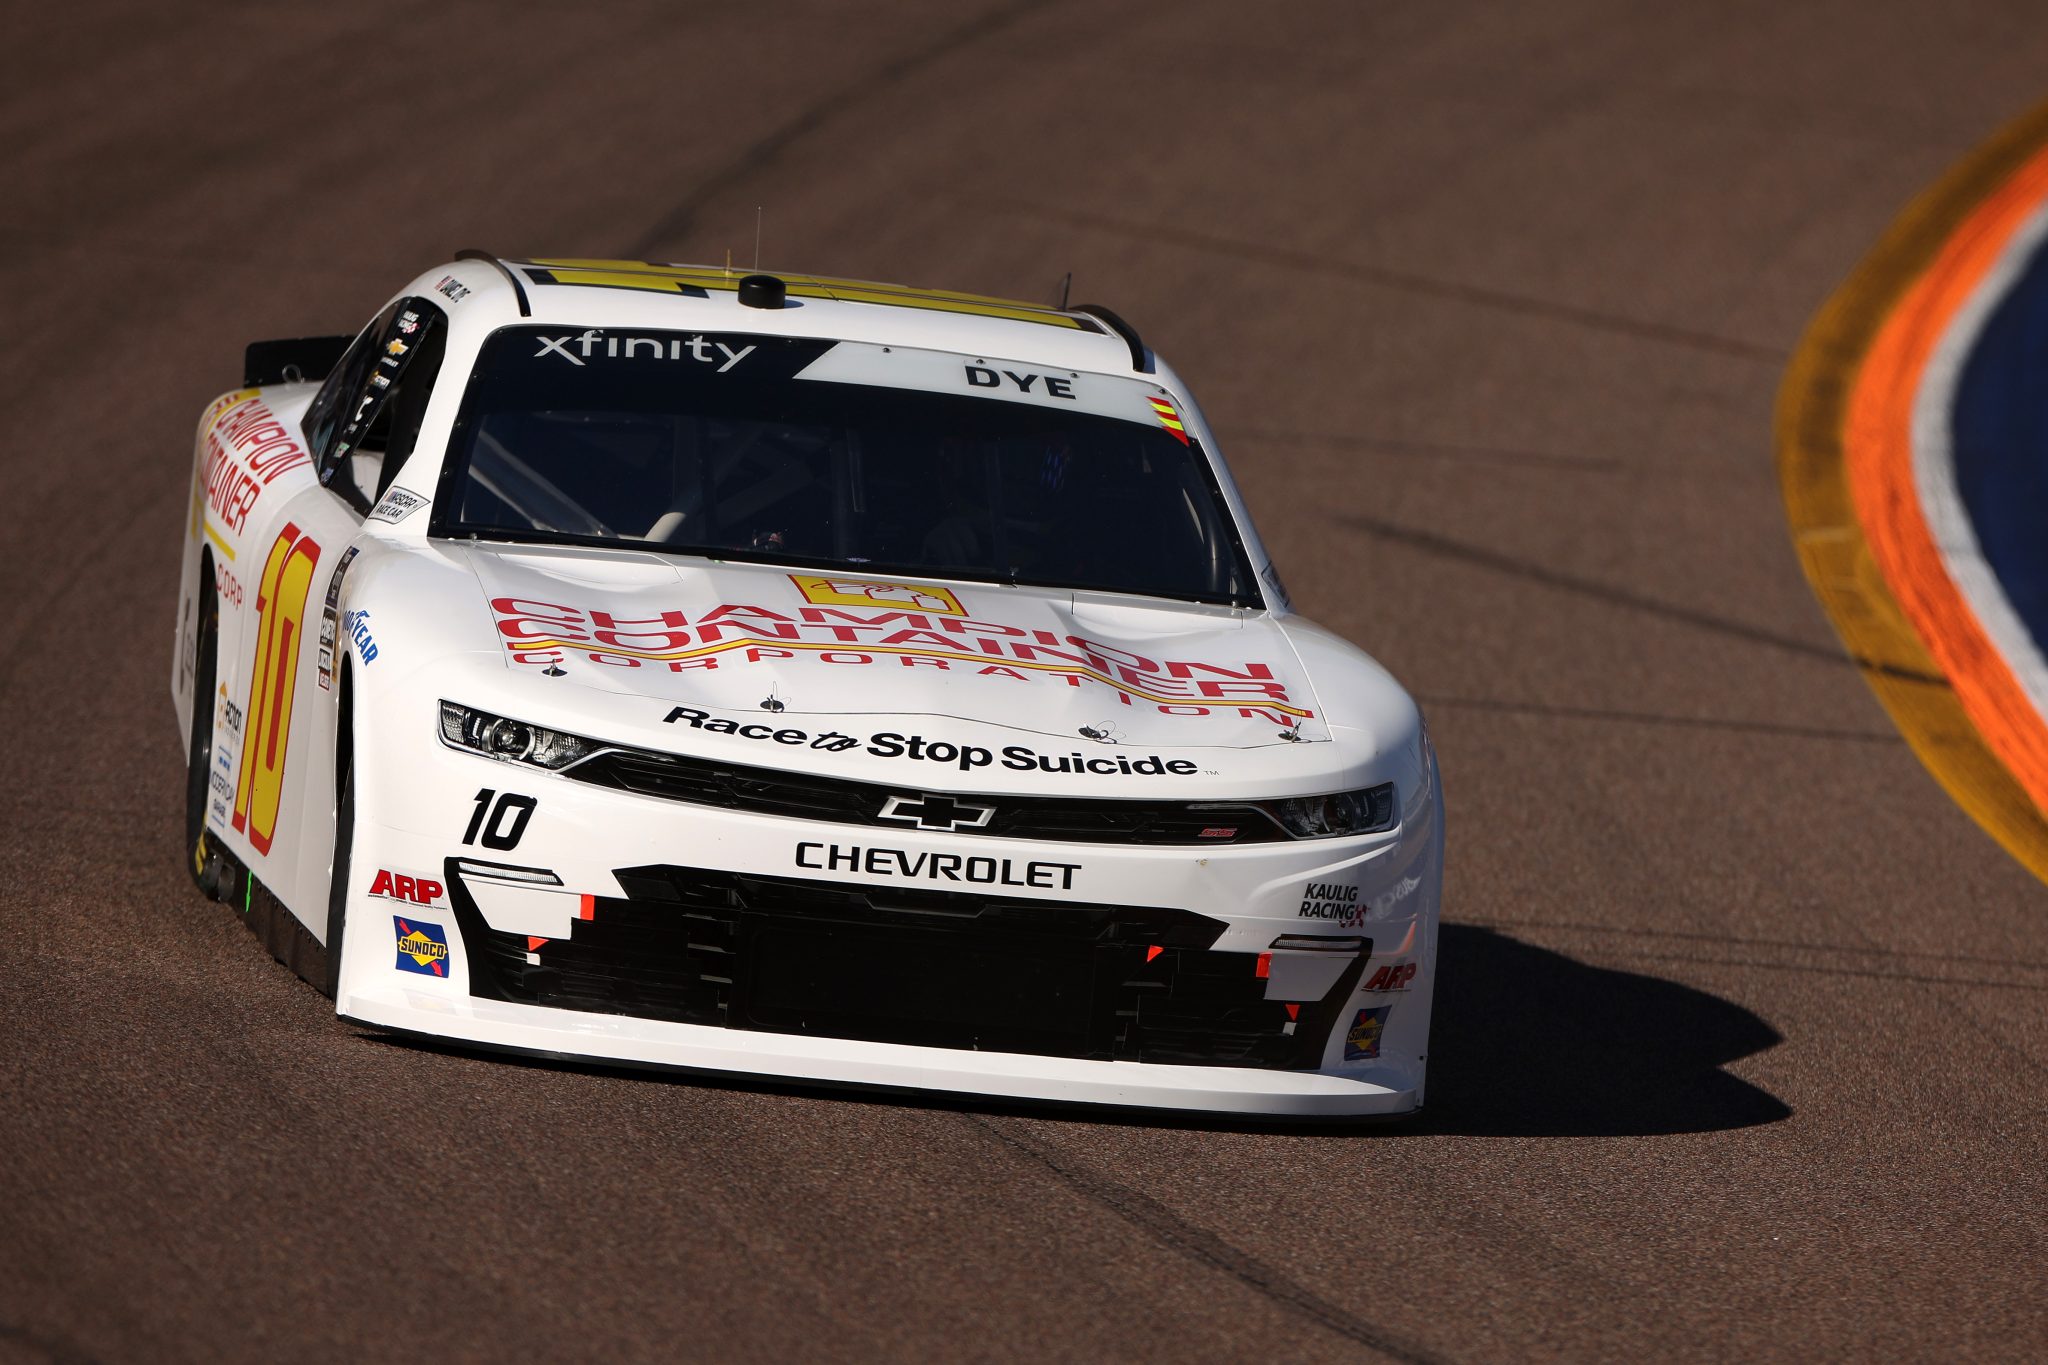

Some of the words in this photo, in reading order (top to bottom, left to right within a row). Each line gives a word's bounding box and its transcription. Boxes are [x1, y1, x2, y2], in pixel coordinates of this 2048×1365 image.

[533, 330, 758, 373] xfinity
[965, 365, 1076, 400] DYE
[215, 562, 243, 611] CORP
[491, 598, 1274, 680] CHAMPION
[498, 618, 1290, 703] CONTAINER
[231, 521, 322, 857] 10
[512, 647, 1296, 728] CORPORATION
[662, 706, 807, 746] Race
[809, 731, 862, 752] to
[866, 731, 993, 771] Stop
[1000, 743, 1198, 776] Suicide
[461, 788, 538, 851] 10
[369, 868, 443, 904] ARP
[795, 841, 1082, 890] CHEVROLET
[1298, 901, 1355, 920] RACING
[1304, 883, 1358, 902] KAULIG
[401, 937, 445, 958] SUNOCO
